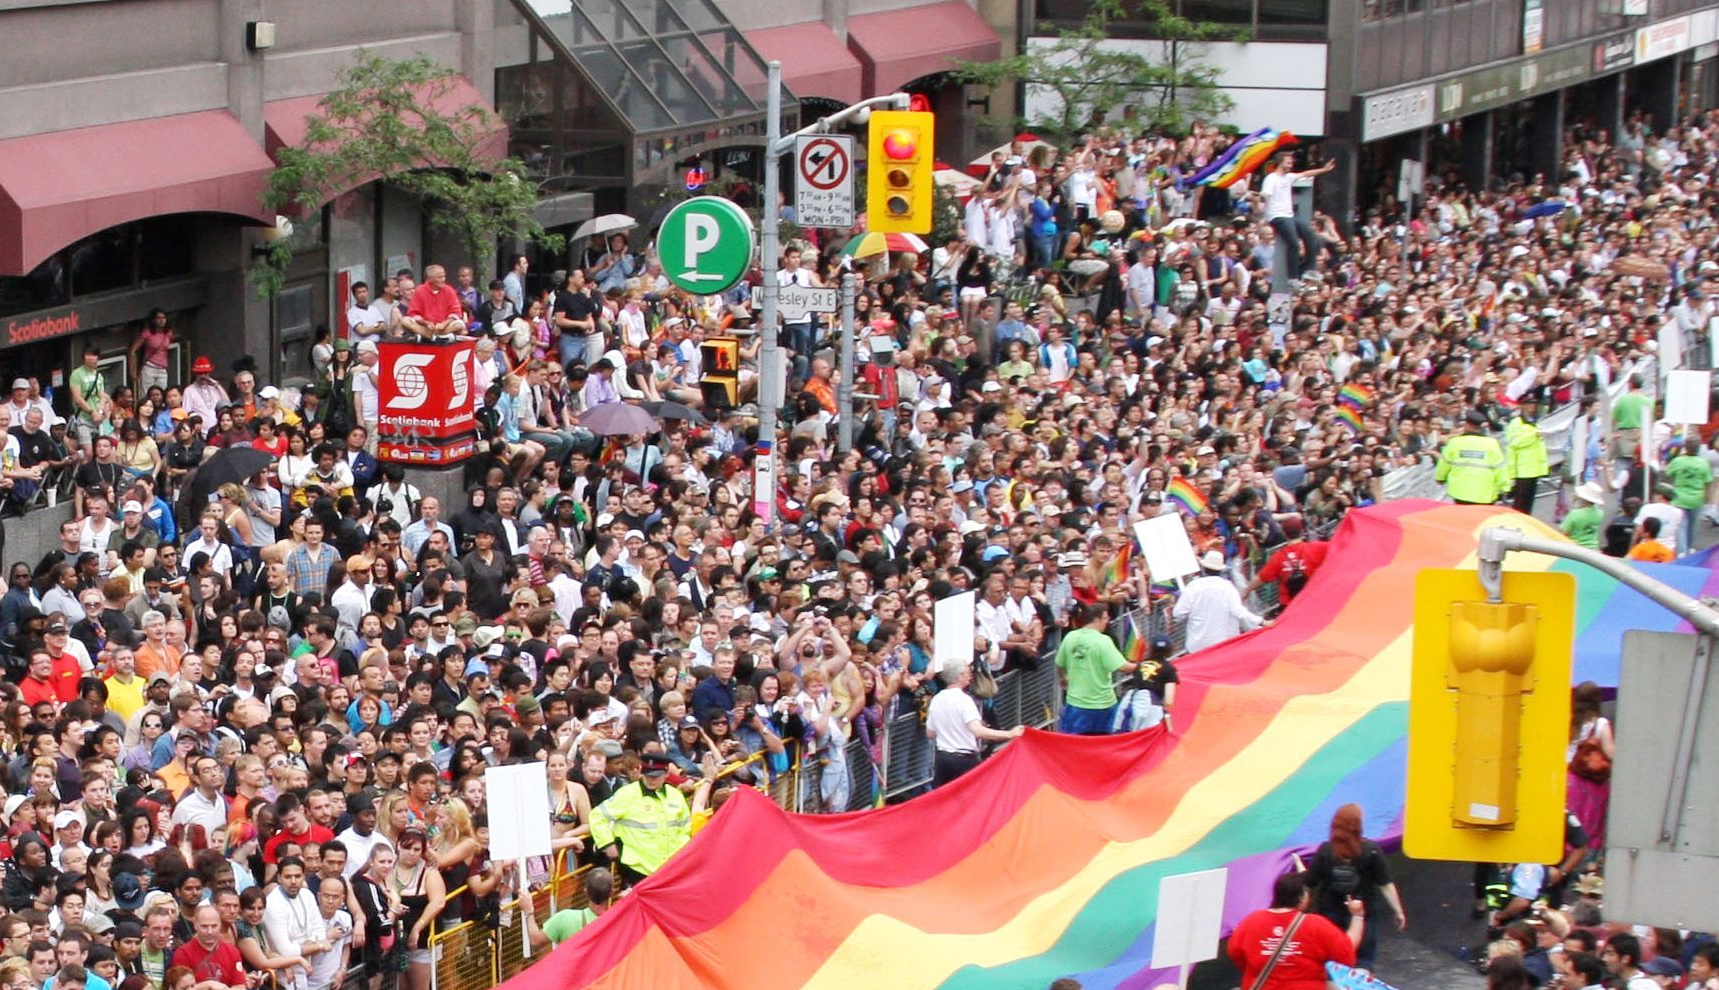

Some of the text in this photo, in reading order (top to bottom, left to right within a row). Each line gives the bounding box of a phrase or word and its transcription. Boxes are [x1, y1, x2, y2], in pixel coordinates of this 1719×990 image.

[684, 213, 720, 268] P
[754, 288, 808, 309] Wesley
[826, 293, 834, 306] E
[9, 310, 79, 344] Scotiabank
[380, 415, 441, 428] Scotiabank
